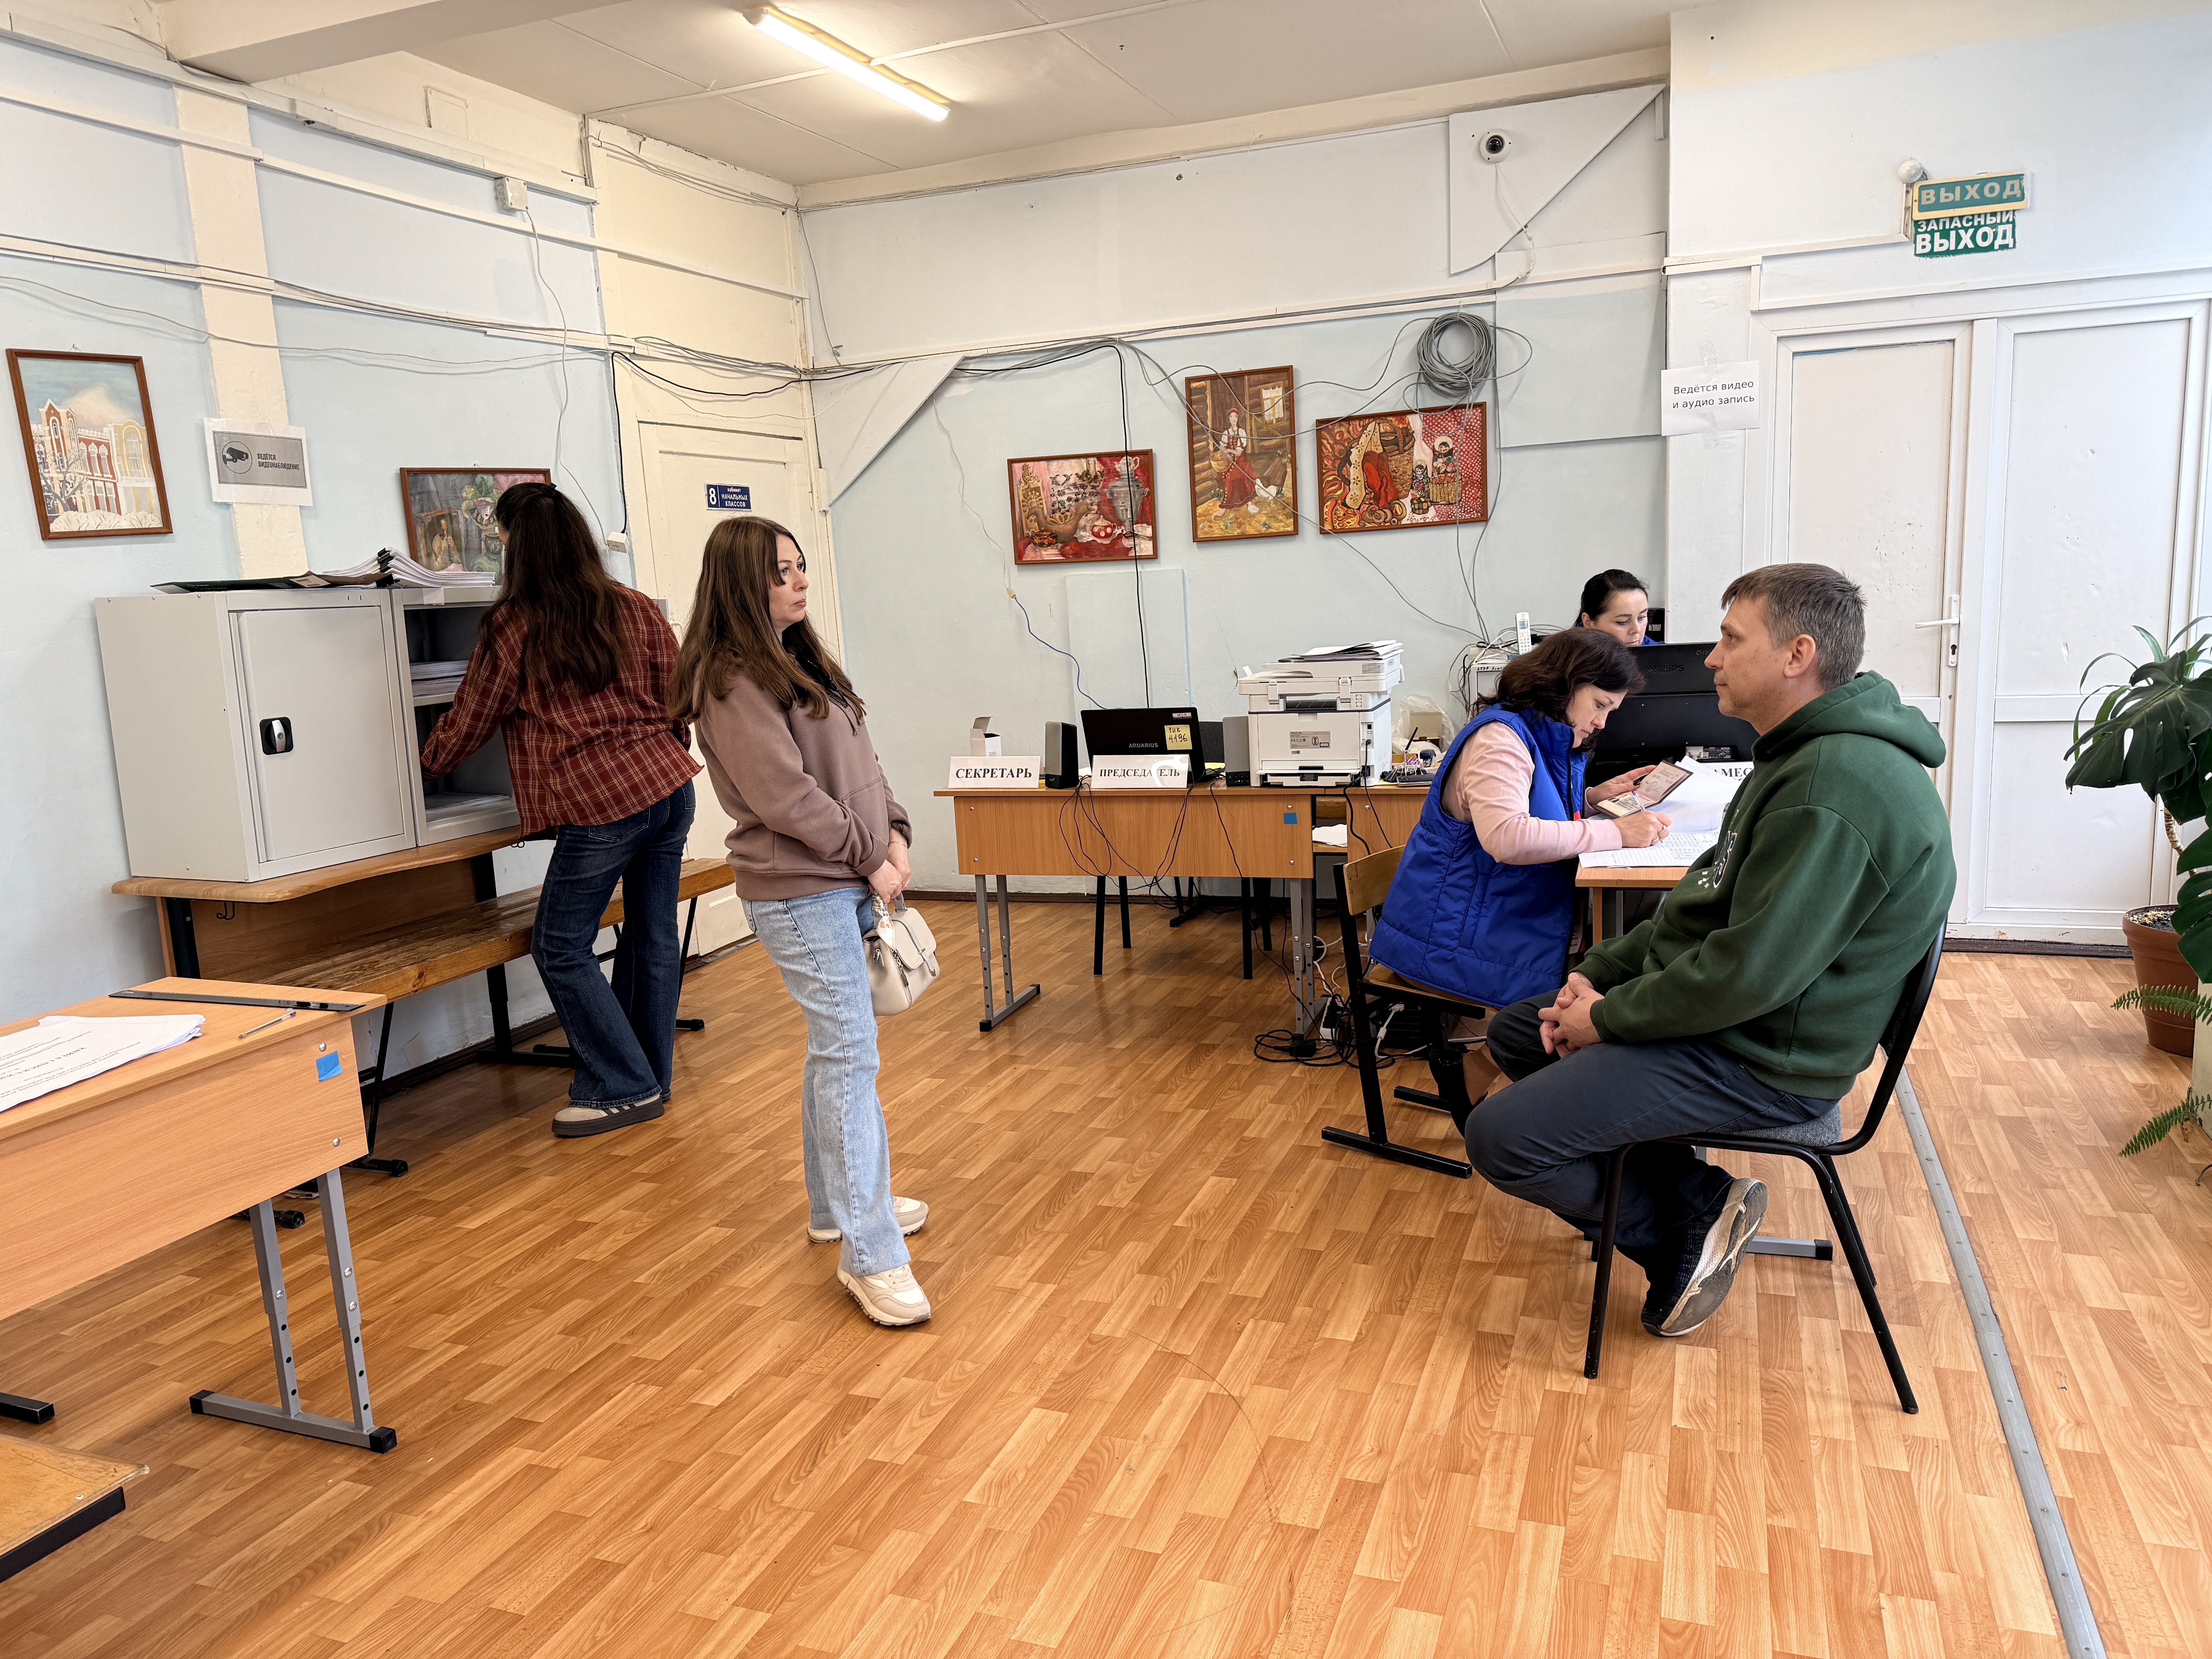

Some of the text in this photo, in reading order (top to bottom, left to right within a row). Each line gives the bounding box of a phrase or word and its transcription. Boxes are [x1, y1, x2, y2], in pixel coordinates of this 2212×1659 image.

[1921, 179, 2021, 205] ВЫХОД
[1916, 224, 2014, 254] ВЫХОД
[1674, 381, 1754, 395] Ведётся видео
[1682, 399, 1714, 409] аудио
[1718, 395, 1755, 404] запись
[258, 461, 300, 470] ВИДЕОНАБЛЮДЕНИЕ
[709, 488, 717, 505] 8
[1169, 733, 1187, 743] 4196
[956, 768, 1032, 778] СЕКРЕТАРЬ
[1100, 769, 1180, 778] ПРЕДСЕДАЕЛЬ
